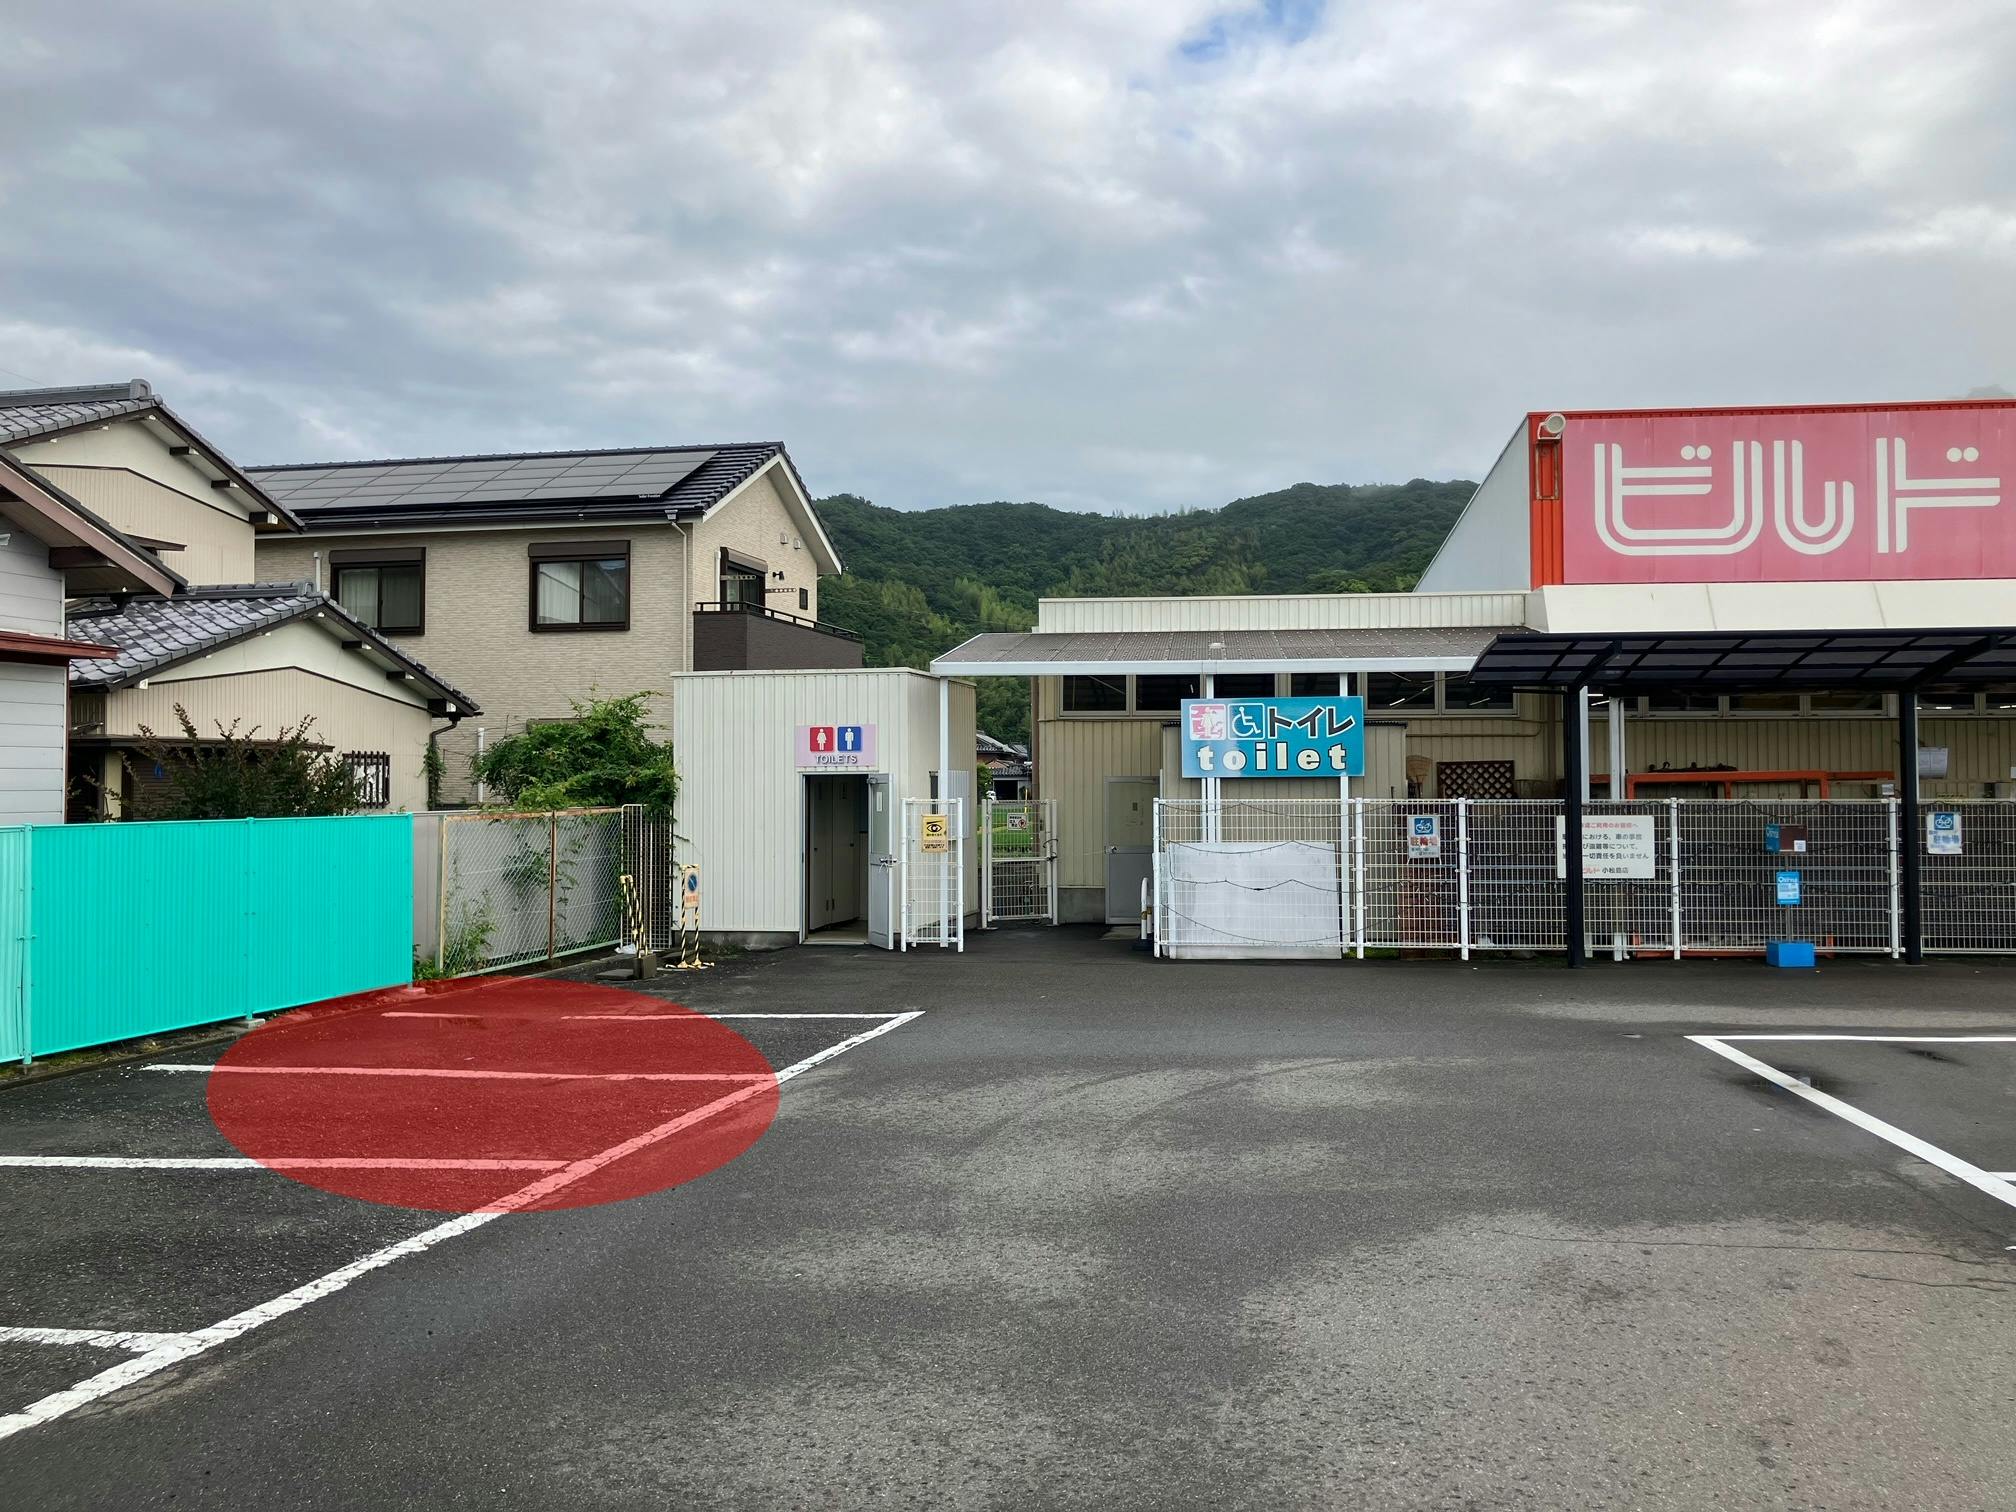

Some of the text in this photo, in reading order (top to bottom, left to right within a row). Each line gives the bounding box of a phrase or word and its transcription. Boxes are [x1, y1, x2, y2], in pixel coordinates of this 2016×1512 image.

[1594, 437, 2001, 556] ビルド
[1267, 704, 1356, 740] トイレ
[815, 754, 858, 765] TOILETS
[1197, 741, 1348, 771] toilet
[1562, 852, 1649, 860] 一切責任を負いません
